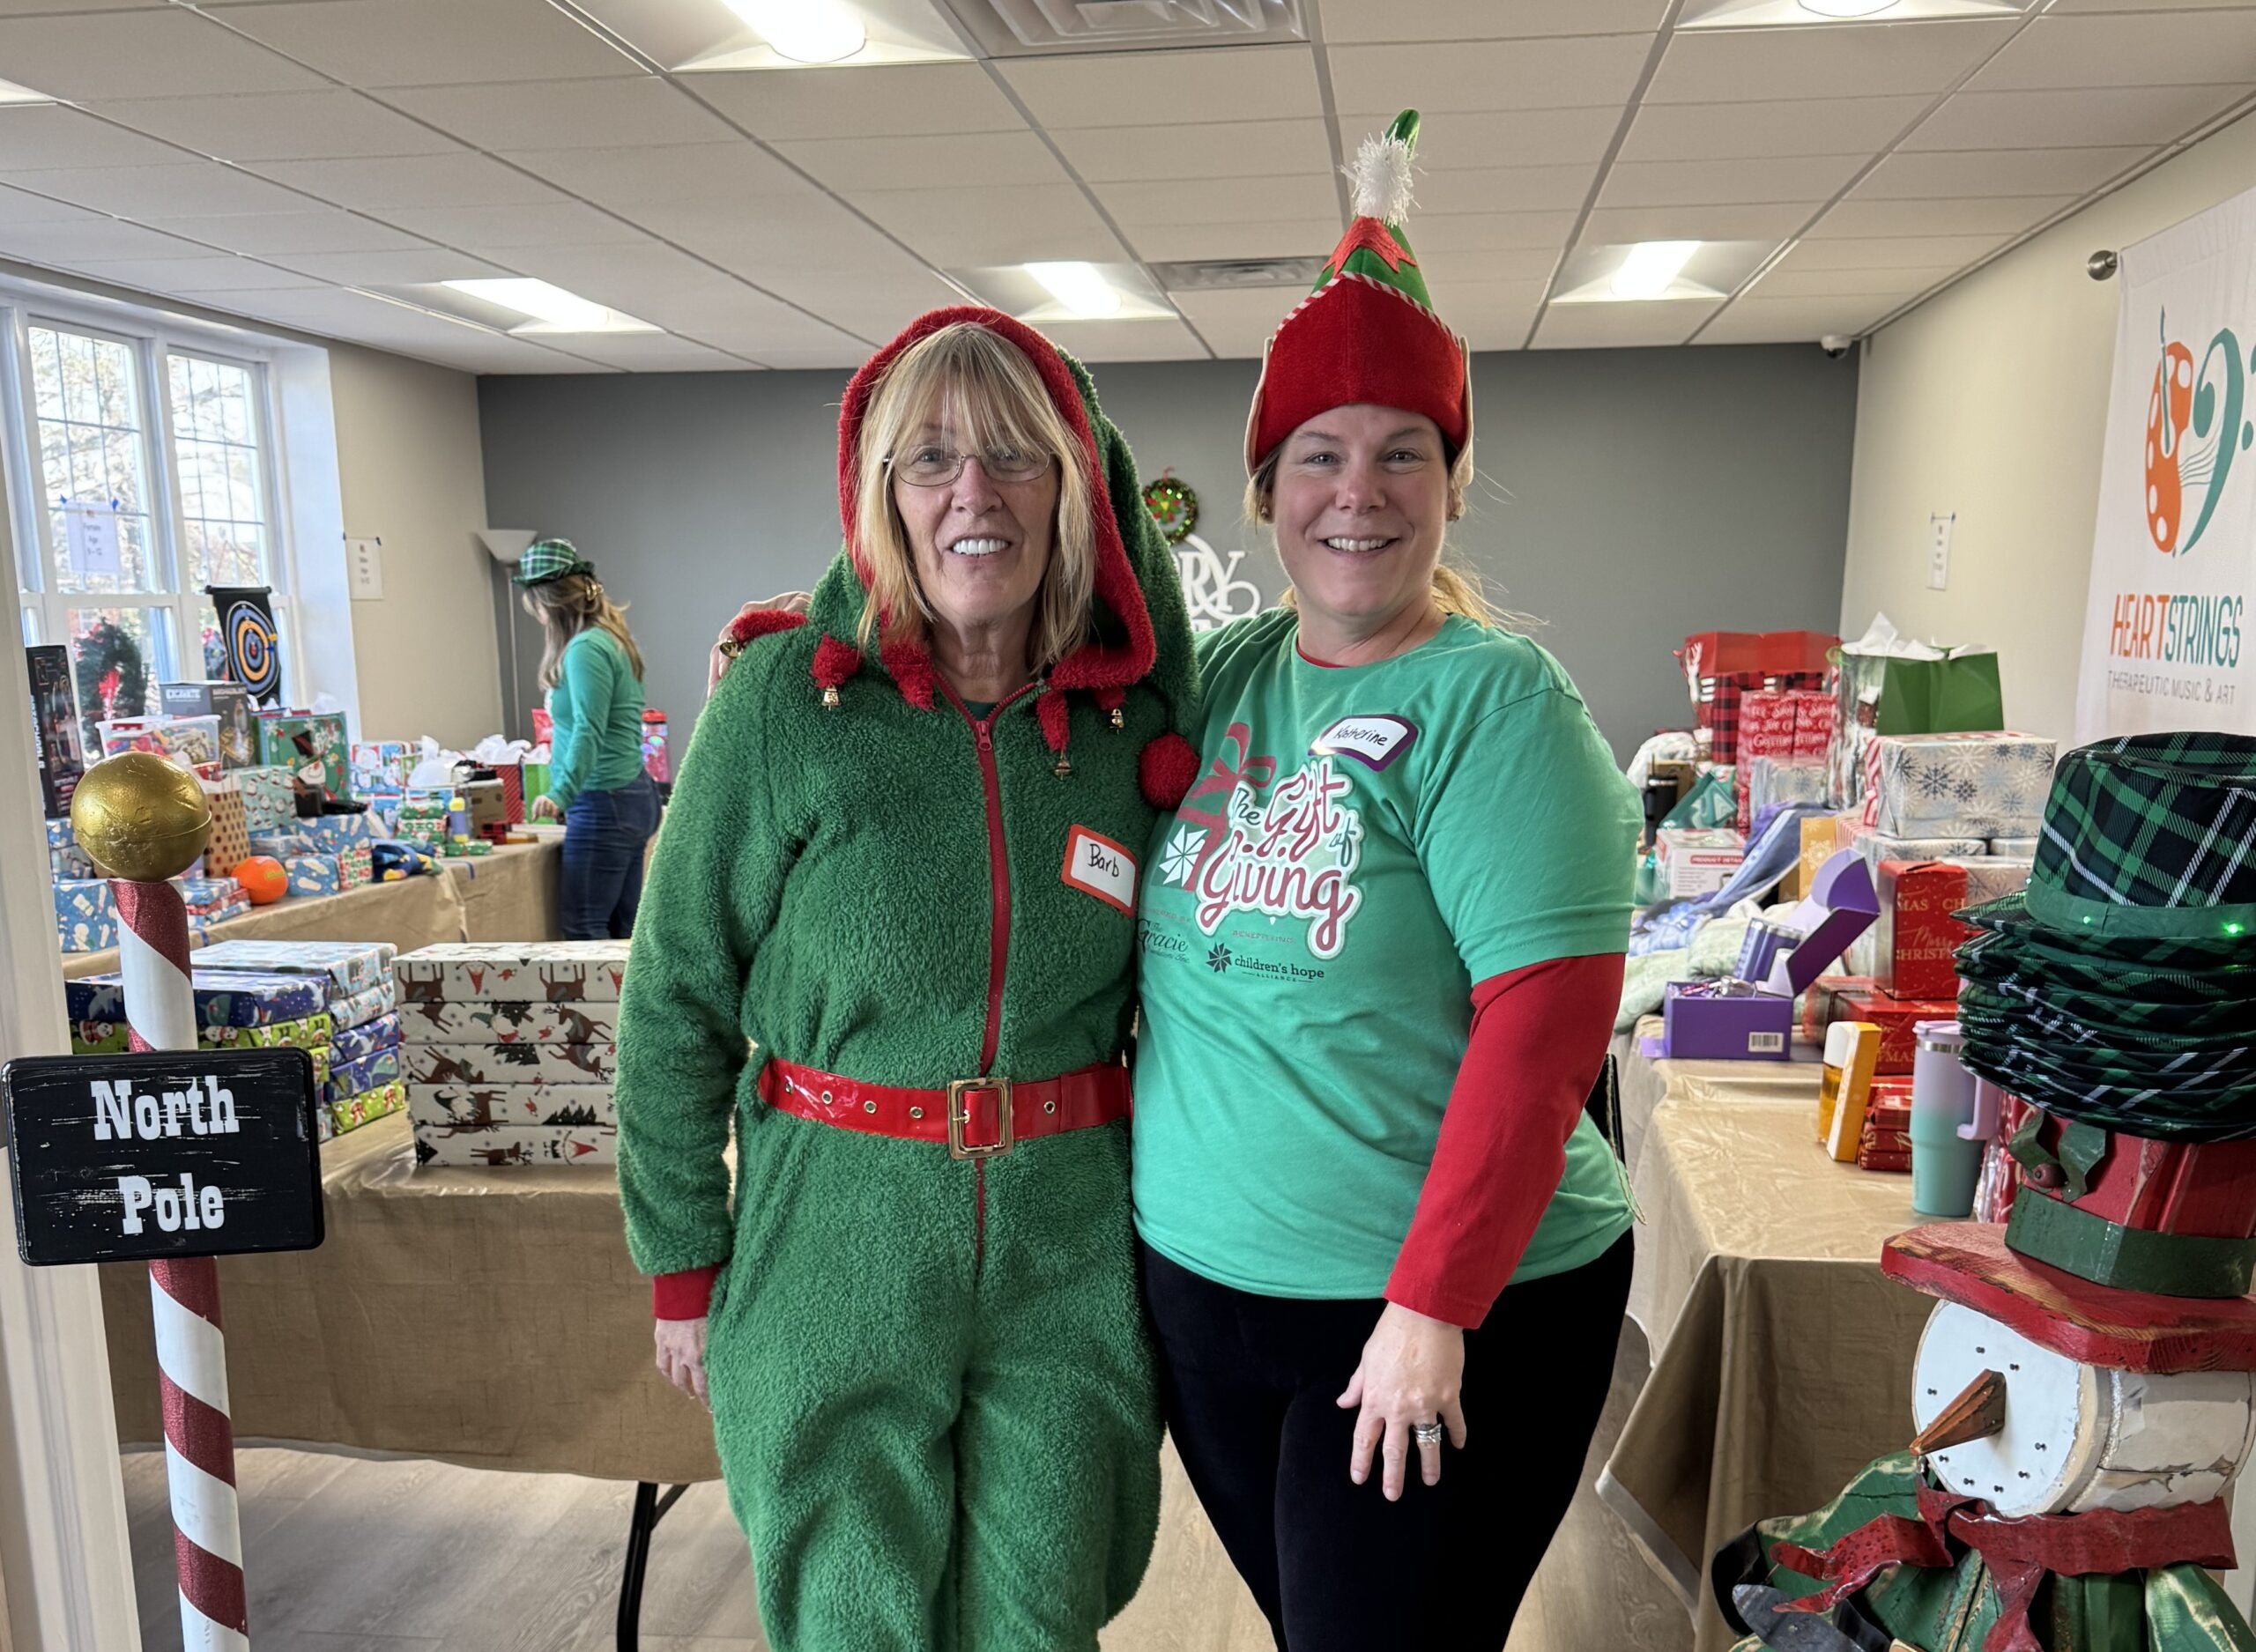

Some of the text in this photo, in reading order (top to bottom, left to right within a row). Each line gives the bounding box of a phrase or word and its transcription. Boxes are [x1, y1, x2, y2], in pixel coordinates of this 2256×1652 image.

[2110, 594, 2243, 668] HEARTSTRINGS
[2171, 679, 2201, 701] MUSIC
[2205, 678, 2213, 703] &
[2215, 685, 2236, 705] ART
[1265, 763, 1346, 863] Gift
[1087, 843, 1119, 878] Barb
[1199, 830, 1354, 951] Giving
[1235, 954, 1325, 980] children's hope
[1256, 973, 1296, 982] ALLIANCE
[91, 1076, 240, 1141] North
[118, 1173, 225, 1234] Pole
